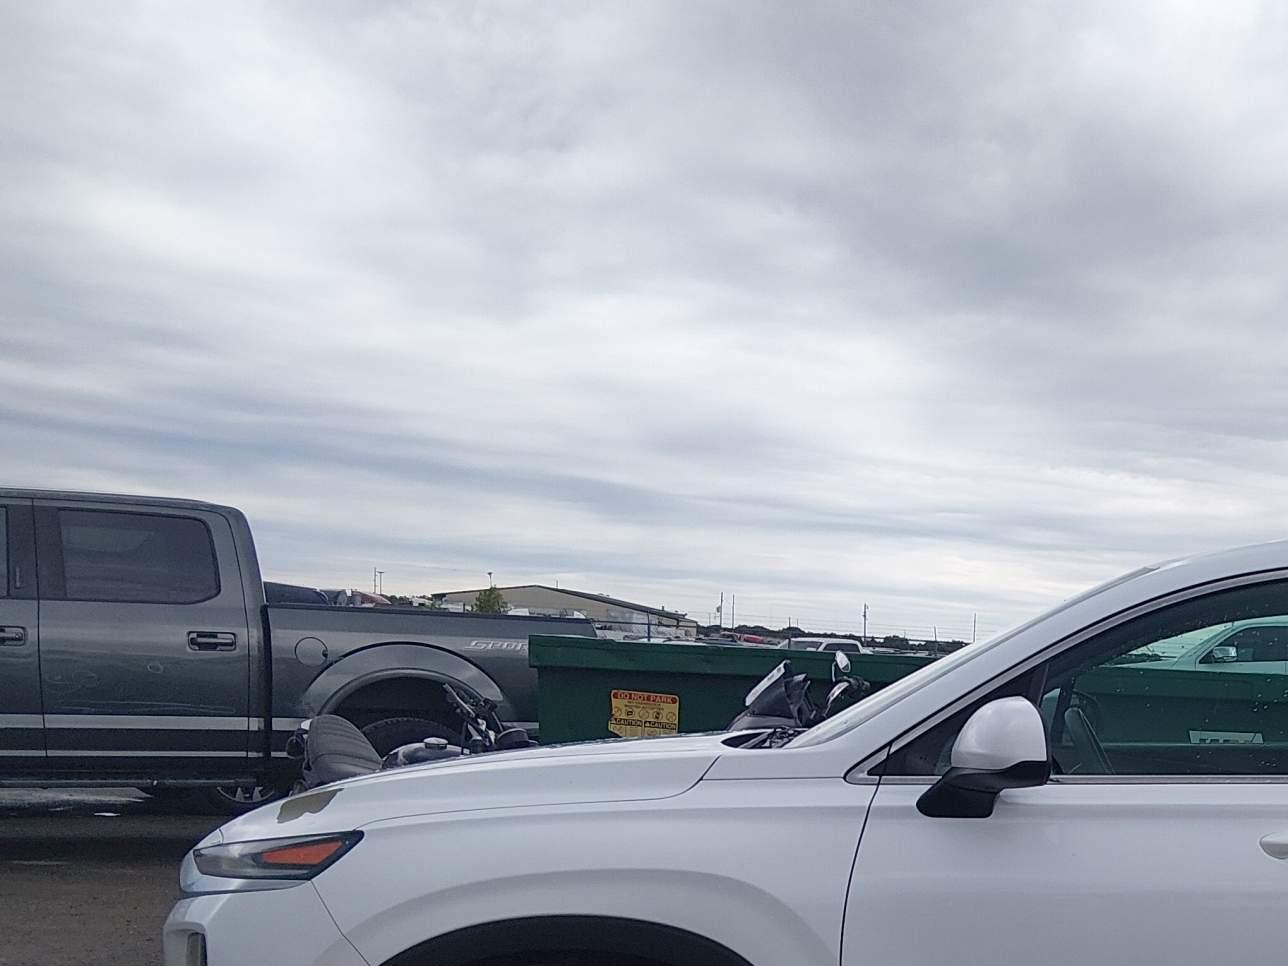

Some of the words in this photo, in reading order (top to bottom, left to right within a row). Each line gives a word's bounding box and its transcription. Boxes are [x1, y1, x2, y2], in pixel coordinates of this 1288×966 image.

[617, 692, 630, 700] DO
[632, 693, 648, 702] NOT
[650, 695, 673, 704] PARK
[616, 719, 642, 727] CAUTION
[650, 722, 676, 730] CAUTION
